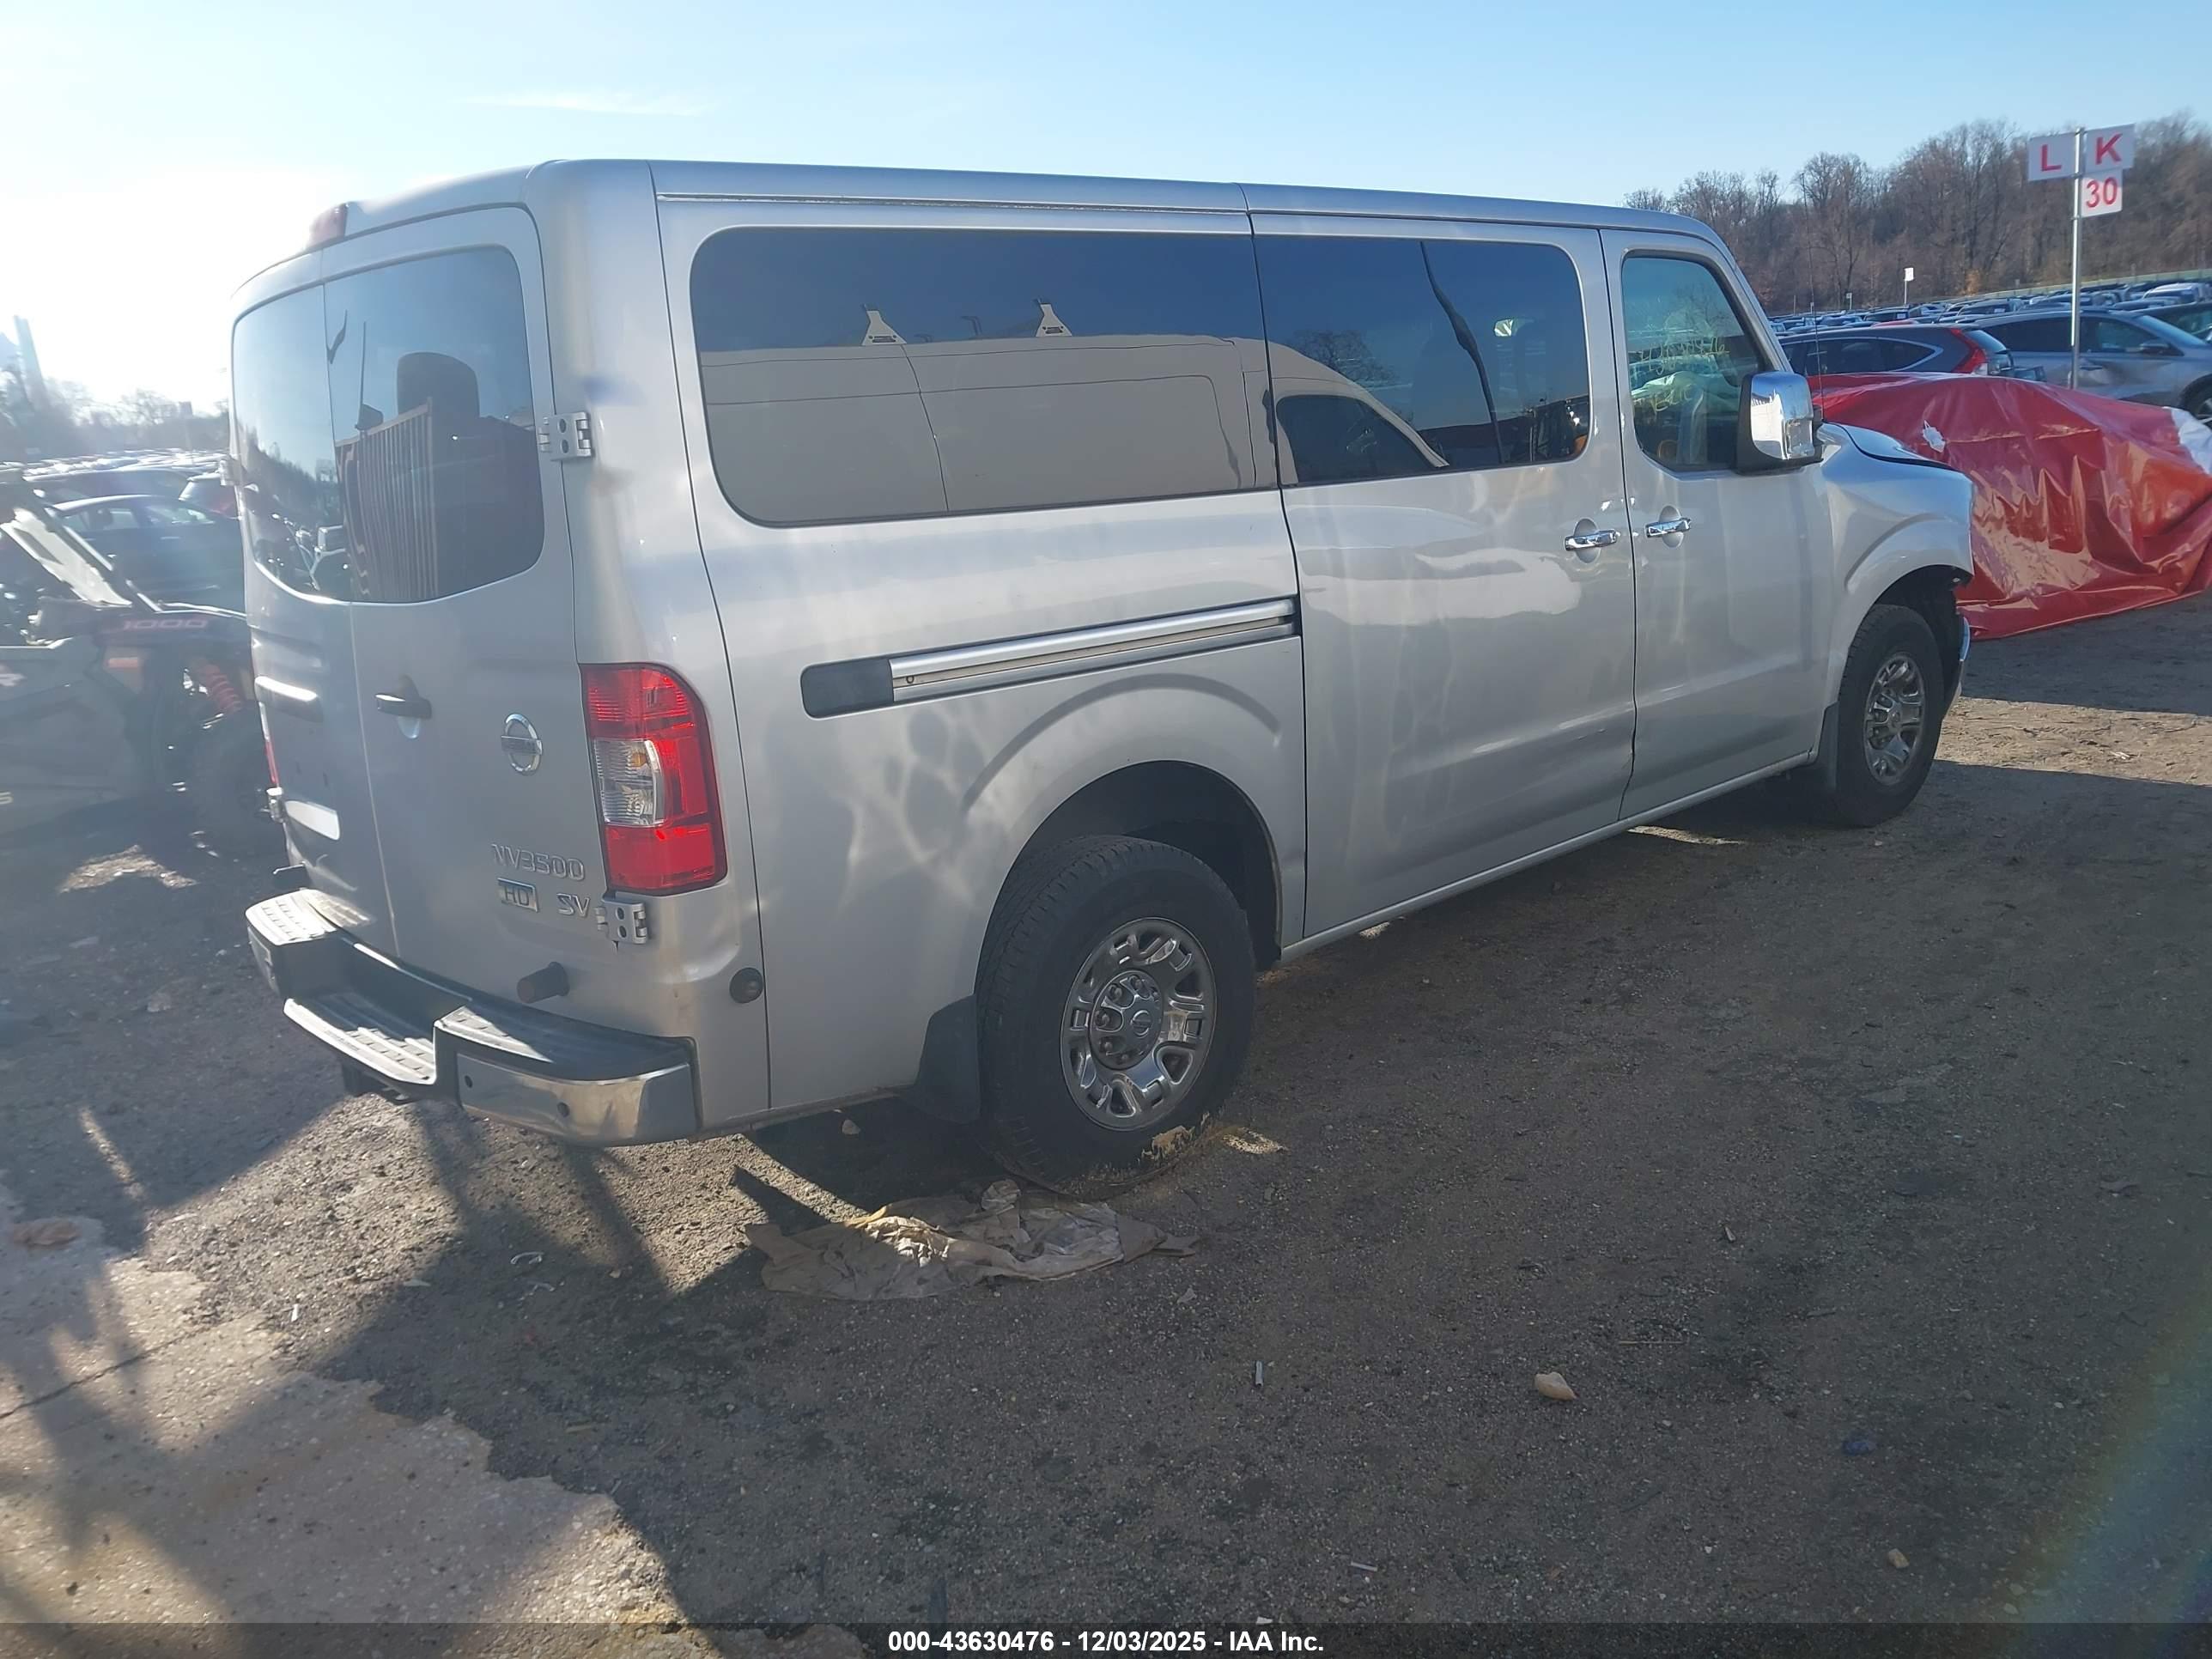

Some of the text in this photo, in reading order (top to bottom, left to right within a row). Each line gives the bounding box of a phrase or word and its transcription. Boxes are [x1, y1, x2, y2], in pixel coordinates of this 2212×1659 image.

[2039, 132, 2124, 172] L K
[2085, 176, 2118, 208] 30
[491, 843, 585, 882] NV3500
[502, 884, 532, 908] HD
[556, 892, 591, 918] SV
